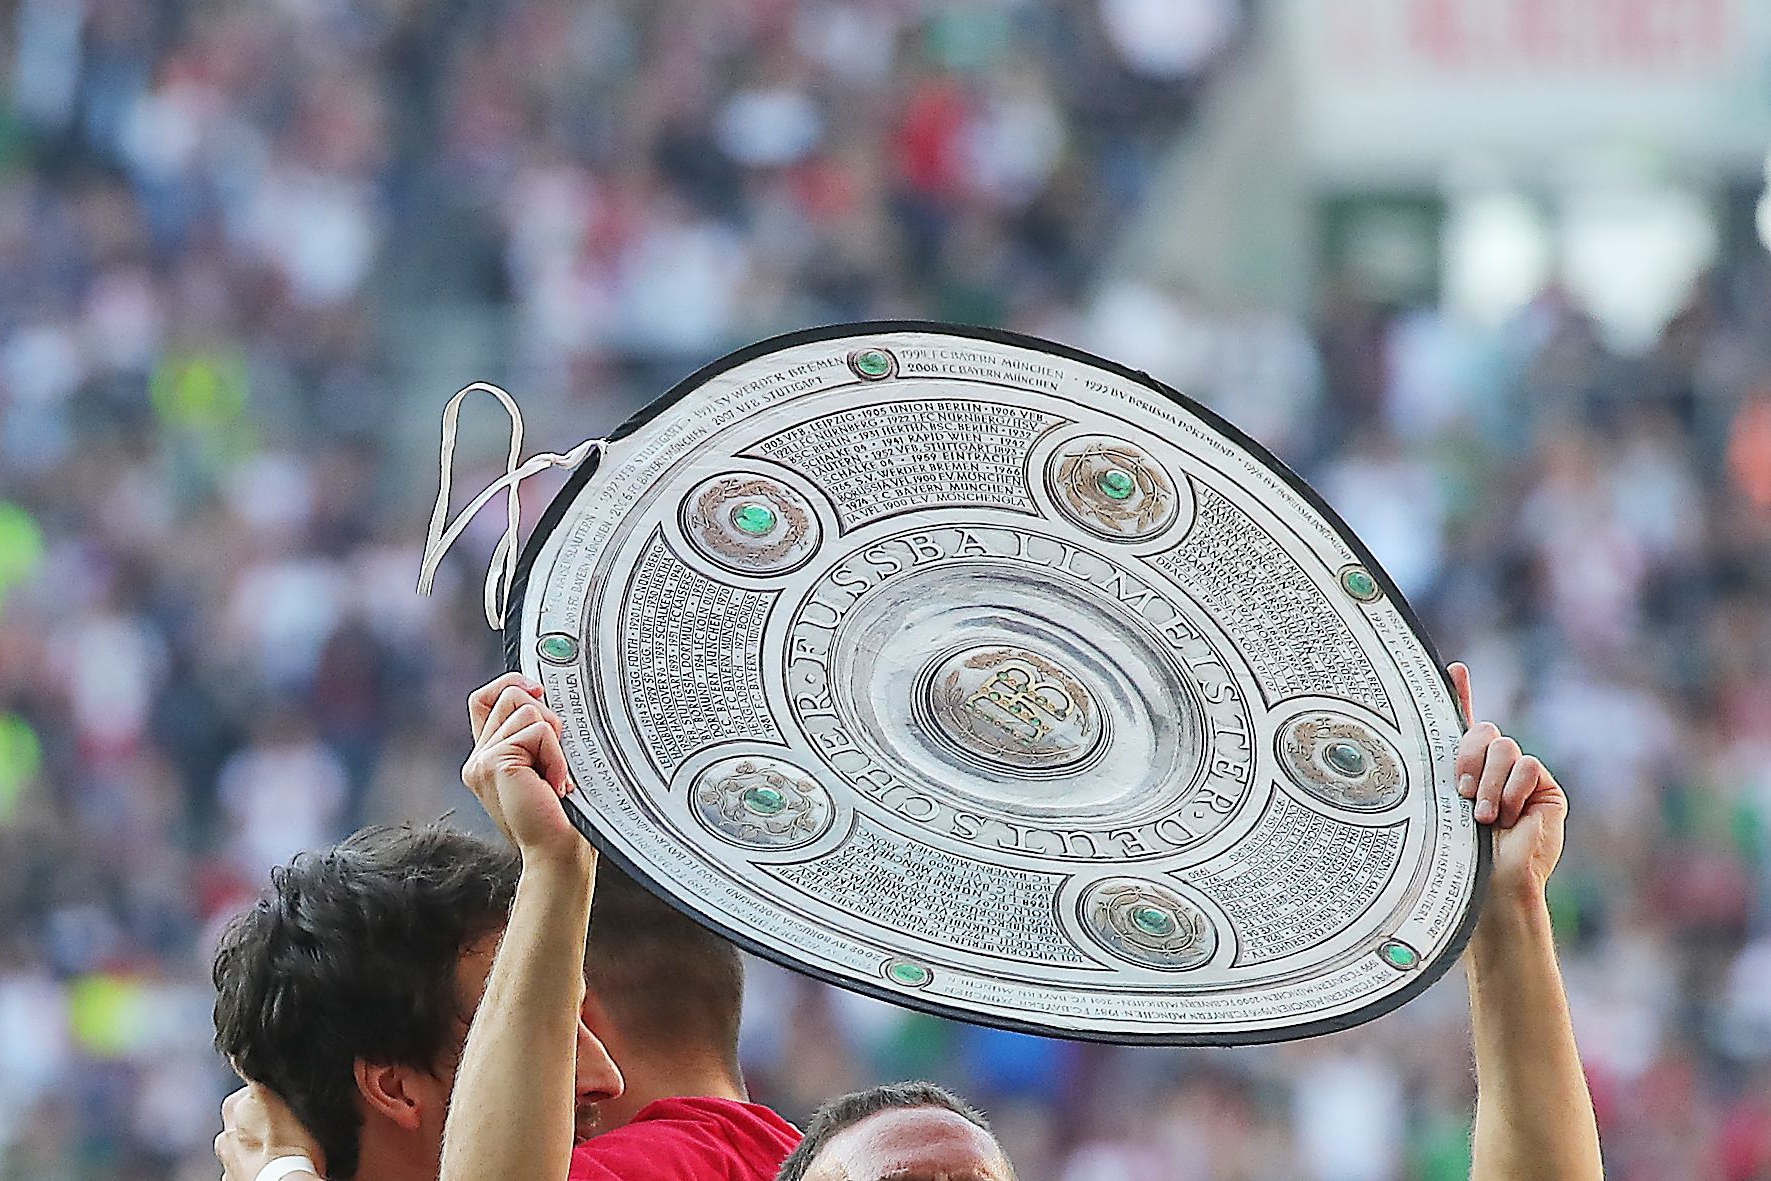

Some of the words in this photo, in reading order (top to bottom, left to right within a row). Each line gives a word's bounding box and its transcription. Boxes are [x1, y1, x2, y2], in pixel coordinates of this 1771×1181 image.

[759, 437, 783, 454] 1903
[809, 412, 855, 431] LEIPZIG
[862, 406, 886, 418] 1905
[888, 402, 934, 413] UNION
[937, 403, 981, 412] BERLIN
[990, 406, 1015, 416] 1906
[813, 434, 851, 452] BERLIN
[859, 429, 879, 439] 1931
[801, 447, 850, 470] SCHALKE
[882, 436, 903, 446] 1941
[907, 431, 944, 442] RAPID
[947, 432, 981, 441] WIEN
[811, 453, 860, 477] LAUTERN
[872, 448, 893, 458] 1952
[822, 460, 875, 484] SCHALKE
[911, 453, 936, 461] 1959
[942, 451, 1016, 464] EINTRACHT
[837, 480, 891, 502] BORUSSIA
[912, 474, 936, 483] 1900
[878, 464, 925, 478] WERDER
[930, 463, 978, 471] BREMEN
[860, 505, 879, 517] VFL
[883, 499, 907, 510] 1900
[896, 483, 943, 496] BAYERN
[1201, 508, 1241, 542] BAYERN
[651, 555, 674, 590] HERTHA
[1156, 556, 1194, 588] DBACH
[1176, 546, 1232, 596] GLADBACH
[654, 599, 670, 638] SCHALKE
[736, 594, 755, 629] BORUSS
[680, 611, 691, 665] DORTMUND
[734, 632, 744, 649] 1977
[656, 667, 665, 676] 96
[720, 654, 732, 691] BAYERN
[747, 653, 758, 689] BAYERN
[790, 528, 1249, 815] FUSSBALLMEISTER
[658, 678, 680, 731] HANNOVER
[671, 673, 690, 725] STUTTGART
[683, 670, 701, 722] BORUSSIA
[697, 680, 722, 738] DORTMUND
[707, 671, 725, 712] BAYERN
[648, 732, 671, 770] LEIPZIG
[653, 711, 681, 761] HAMBURG
[795, 690, 1199, 860] DEUTSCHER
